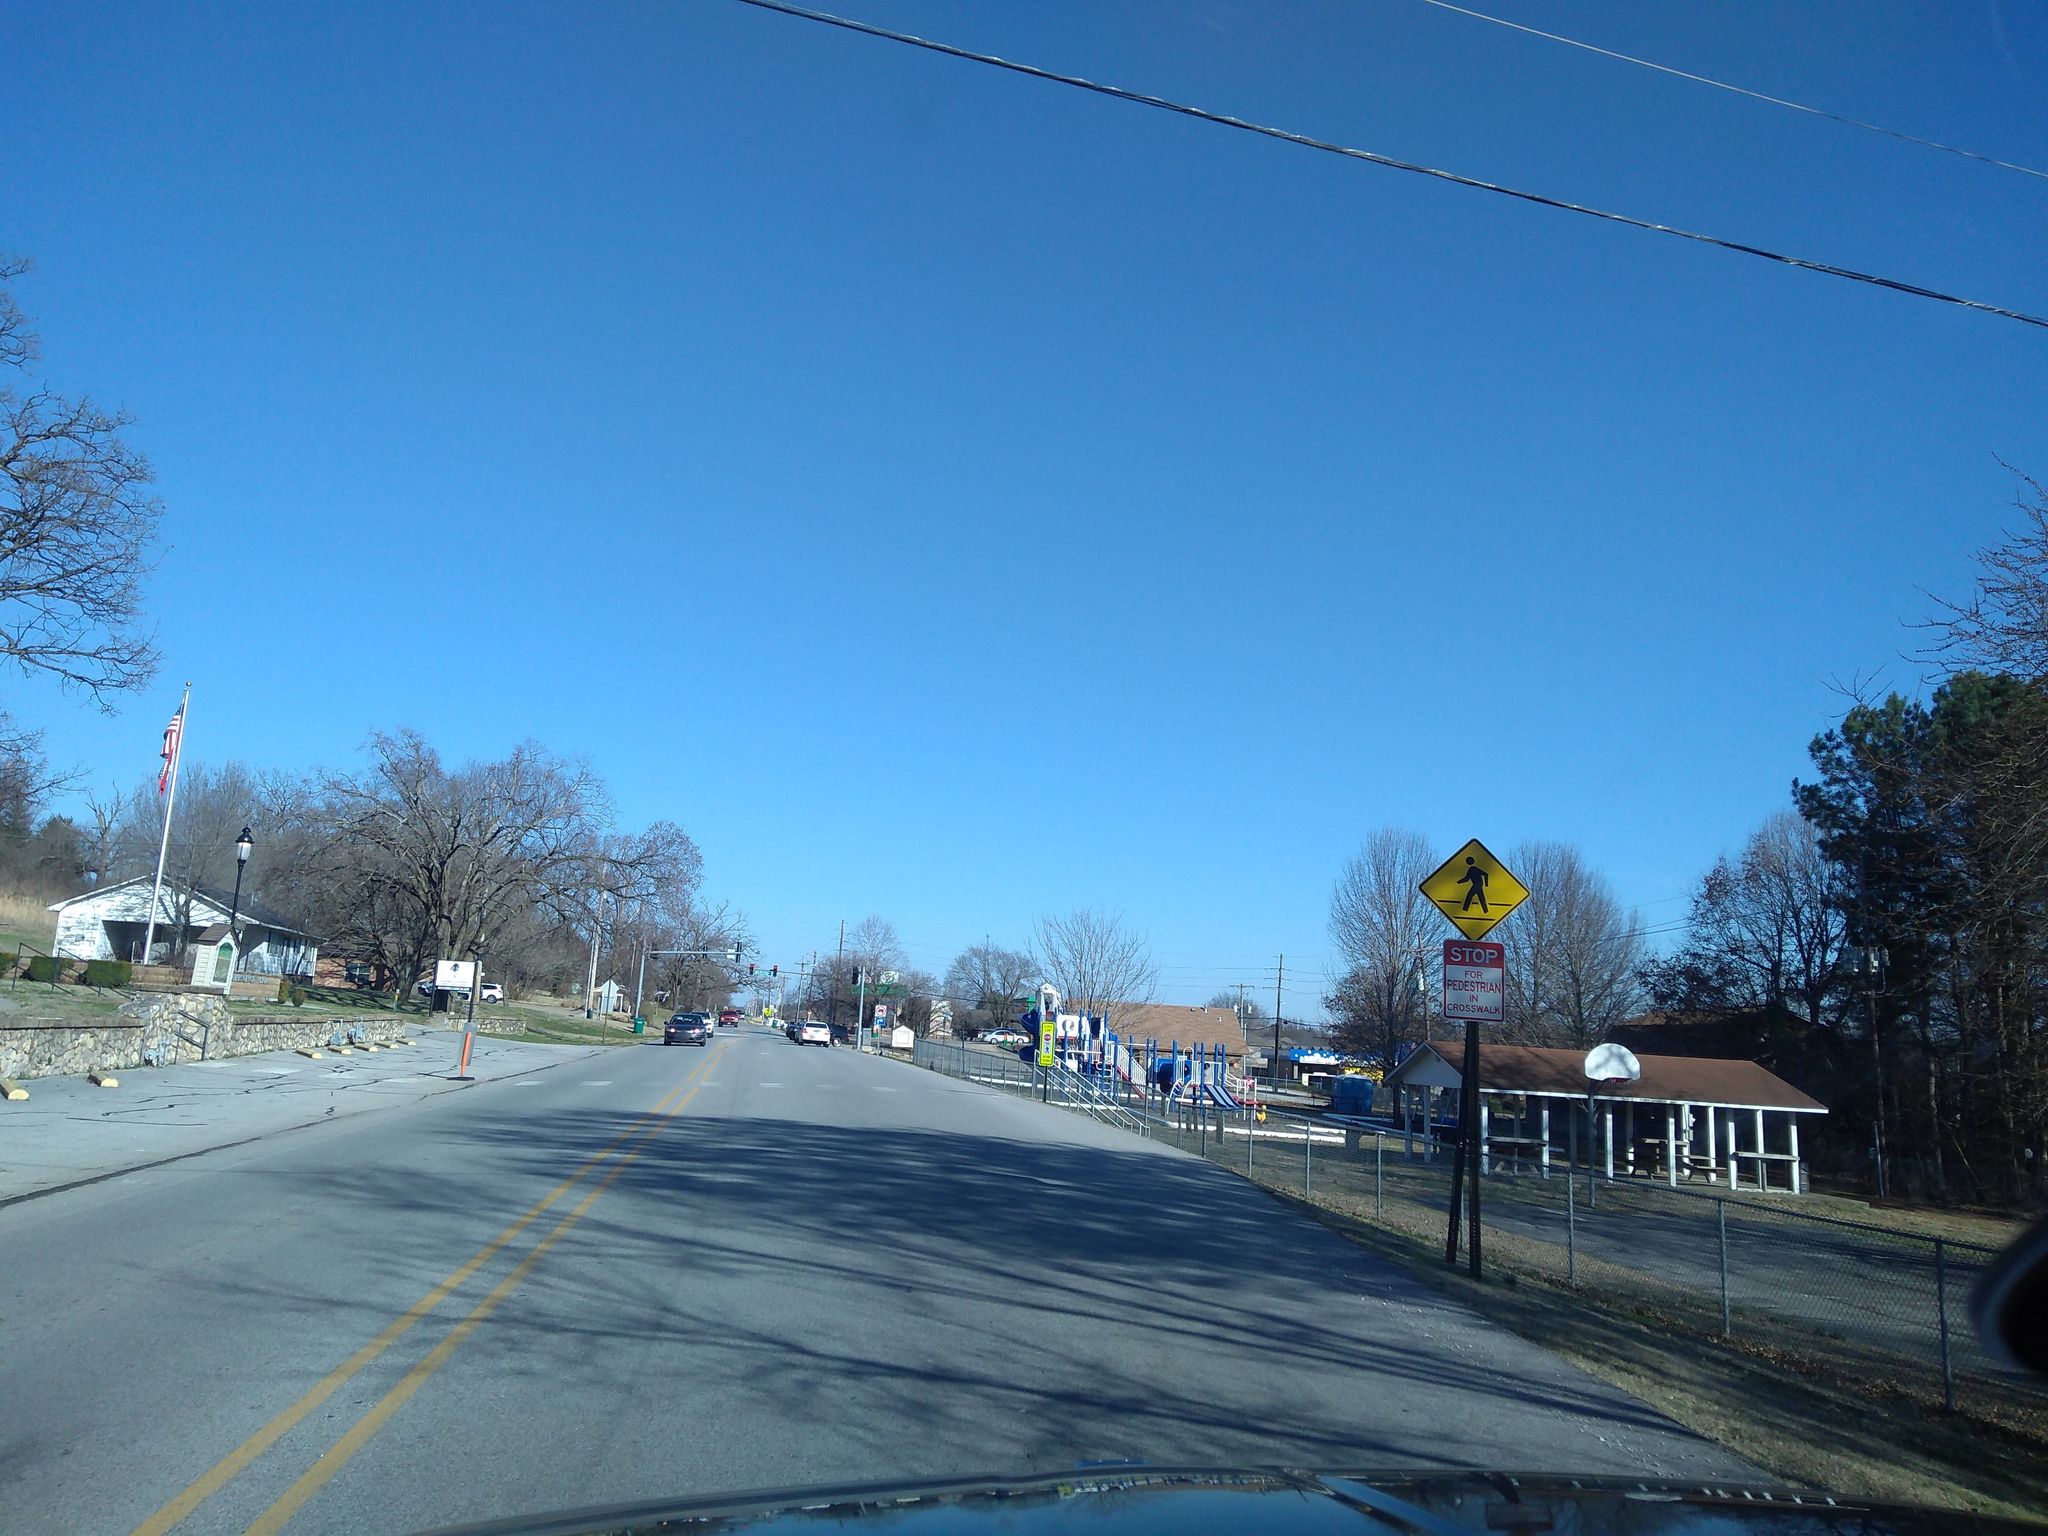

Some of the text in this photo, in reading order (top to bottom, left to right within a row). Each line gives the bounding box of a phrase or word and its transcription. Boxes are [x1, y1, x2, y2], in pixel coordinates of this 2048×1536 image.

[1450, 947, 1498, 963] STOP
[1464, 970, 1483, 979] FOR
[1447, 979, 1501, 994] PEDESTRIAN
[1469, 994, 1478, 1002] IN
[1447, 1003, 1501, 1014] CROSSWALK
